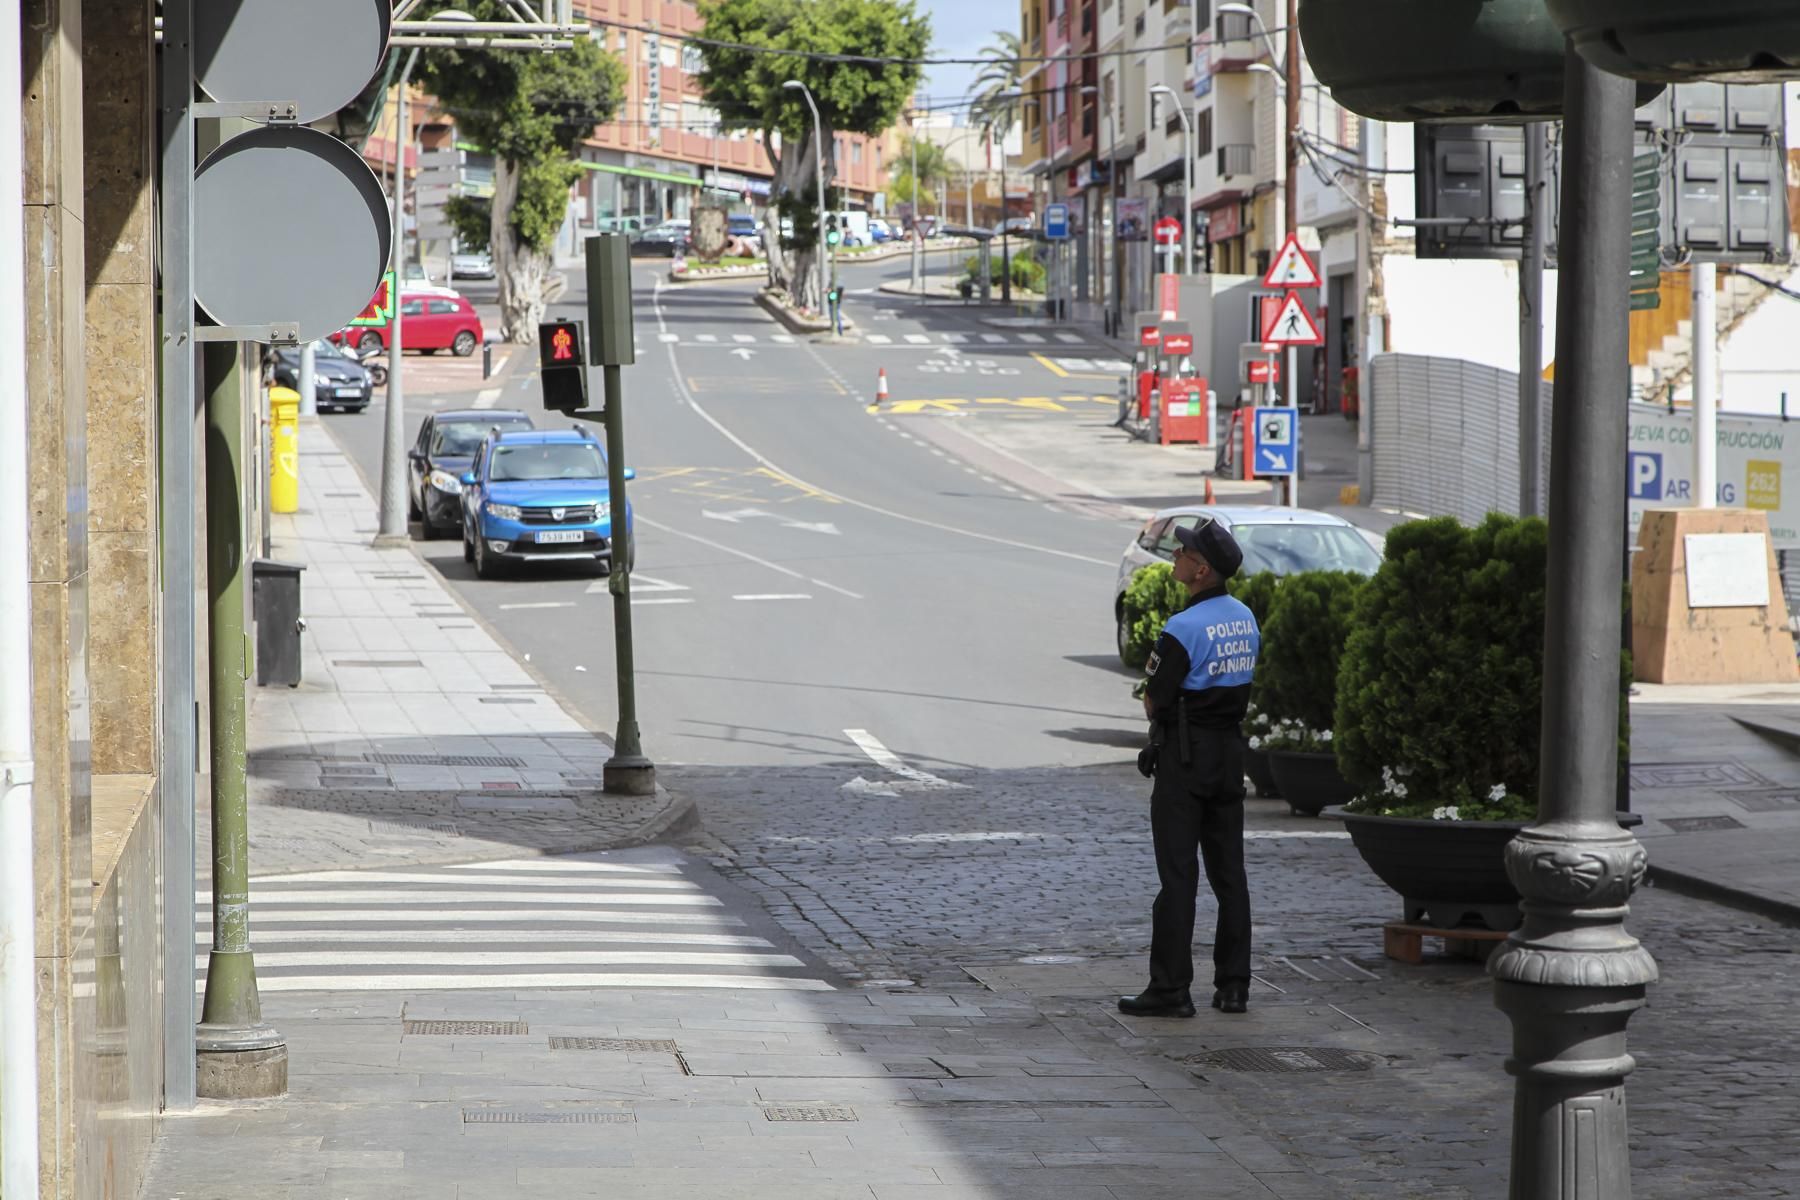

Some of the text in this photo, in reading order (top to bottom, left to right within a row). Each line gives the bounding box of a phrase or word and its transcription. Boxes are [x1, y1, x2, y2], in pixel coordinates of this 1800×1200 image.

[1629, 425, 1784, 450] UEVA CORUCCIÓN
[1749, 472, 1777, 491] 262
[1206, 620, 1254, 640] POLICIA
[1216, 640, 1252, 657] LOCAL
